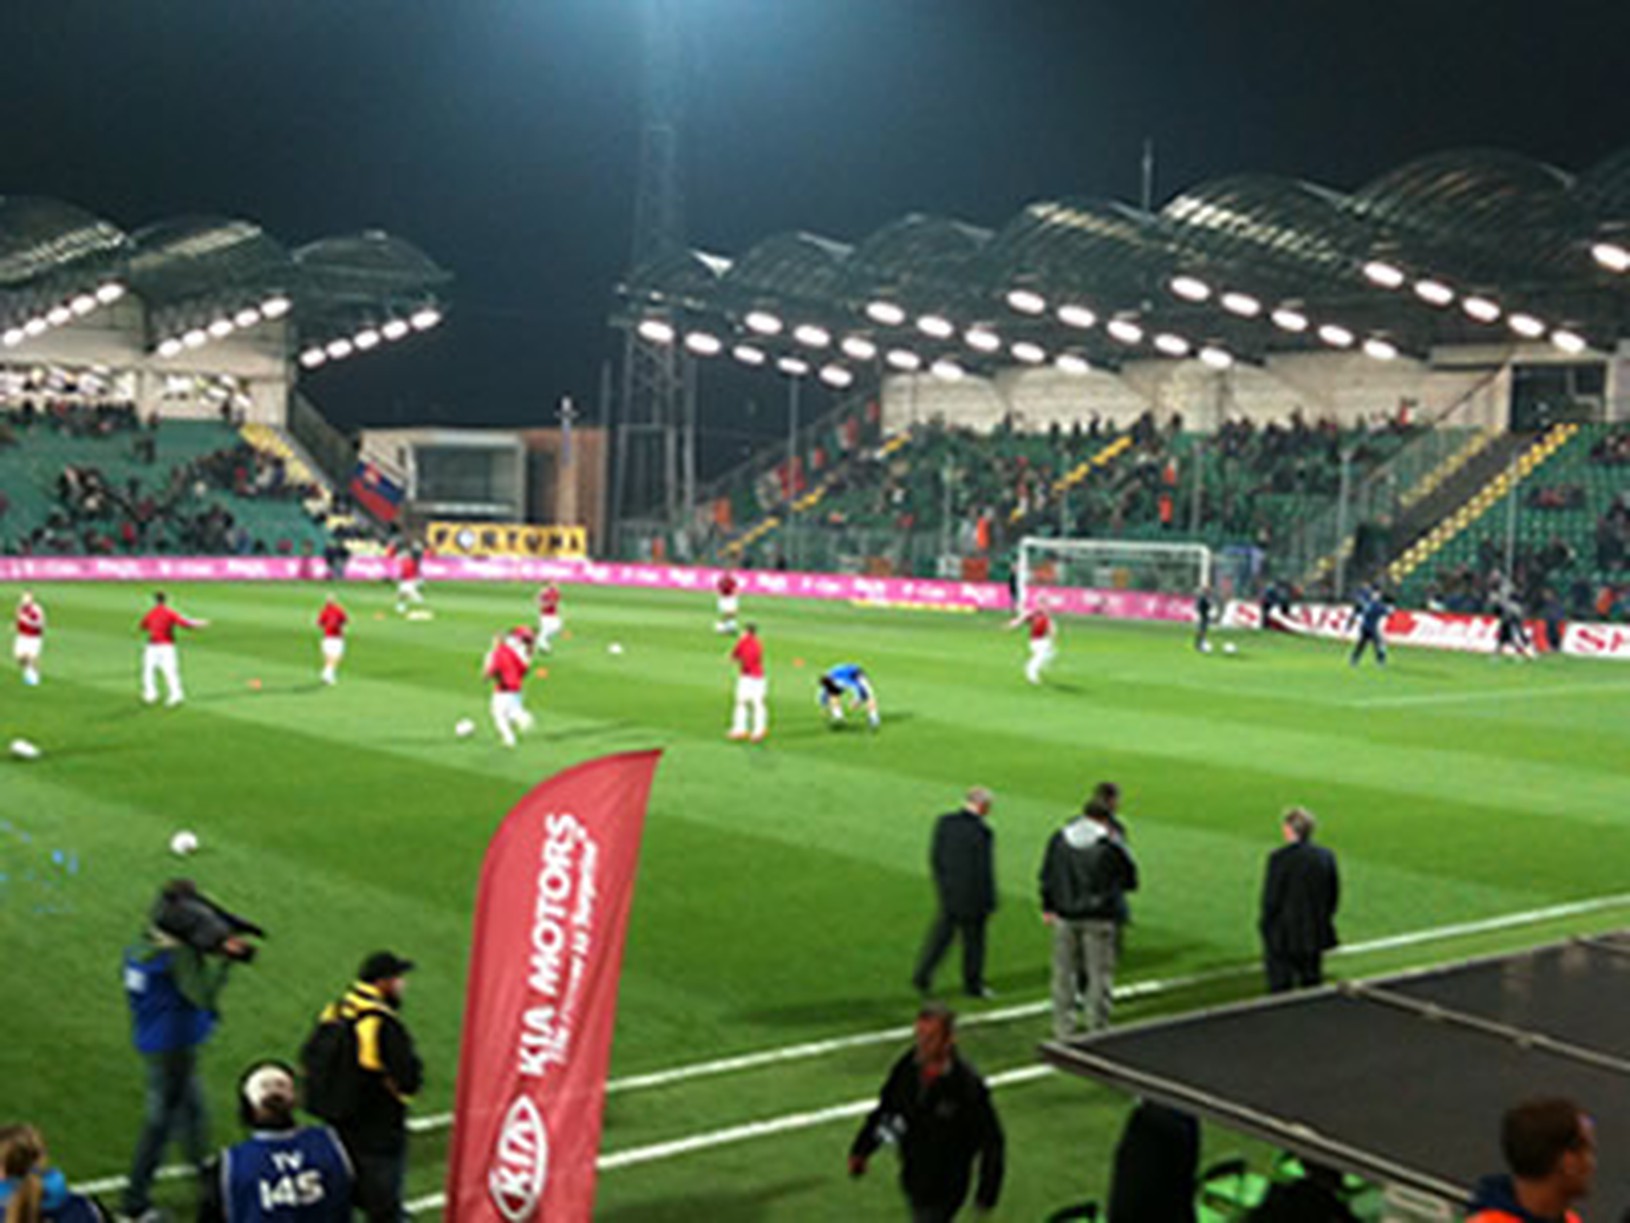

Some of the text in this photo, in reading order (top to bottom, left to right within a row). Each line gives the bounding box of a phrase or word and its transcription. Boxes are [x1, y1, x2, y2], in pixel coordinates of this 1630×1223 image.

[528, 812, 577, 997] MOTORS
[519, 1004, 556, 1076] KIA
[271, 1150, 304, 1172] TV
[259, 1169, 325, 1212] 145
